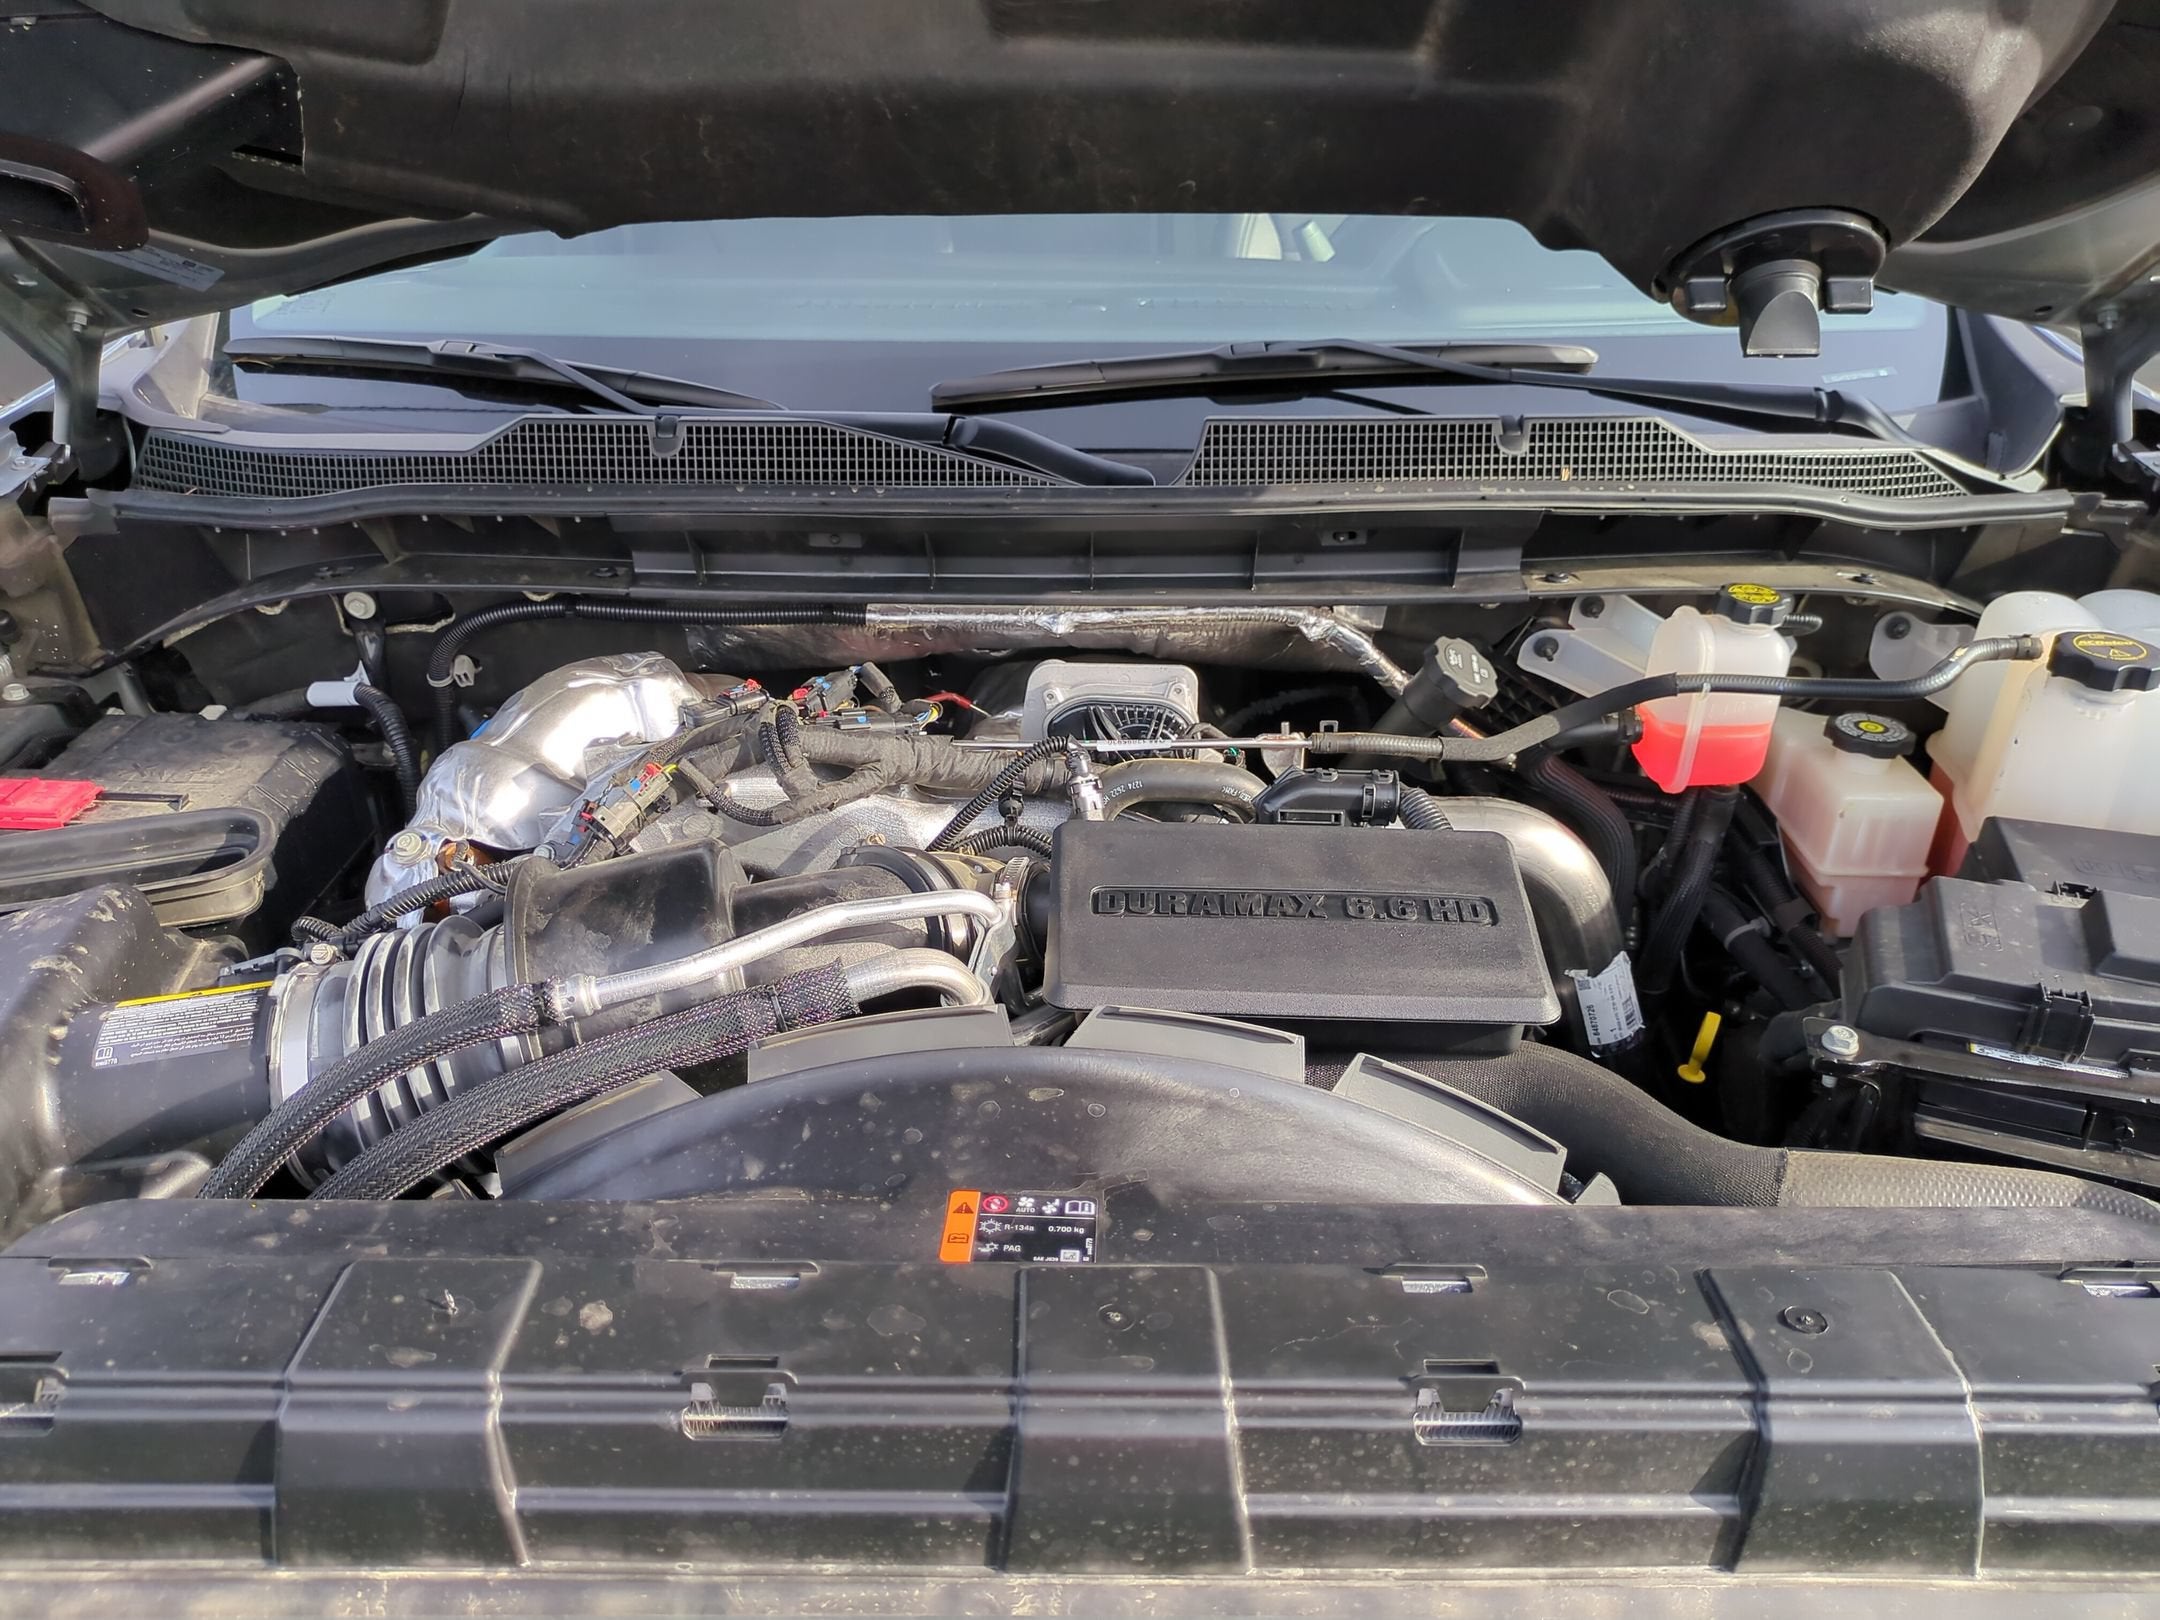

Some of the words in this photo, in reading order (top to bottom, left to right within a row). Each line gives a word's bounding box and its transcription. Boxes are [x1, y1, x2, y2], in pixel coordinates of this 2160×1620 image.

[1098, 891, 1328, 919] DURAMAX
[1346, 896, 1418, 921] 6.6
[1427, 898, 1493, 926] HD
[1004, 1224, 1035, 1232] R-134a
[1003, 1244, 1022, 1252] PAG
